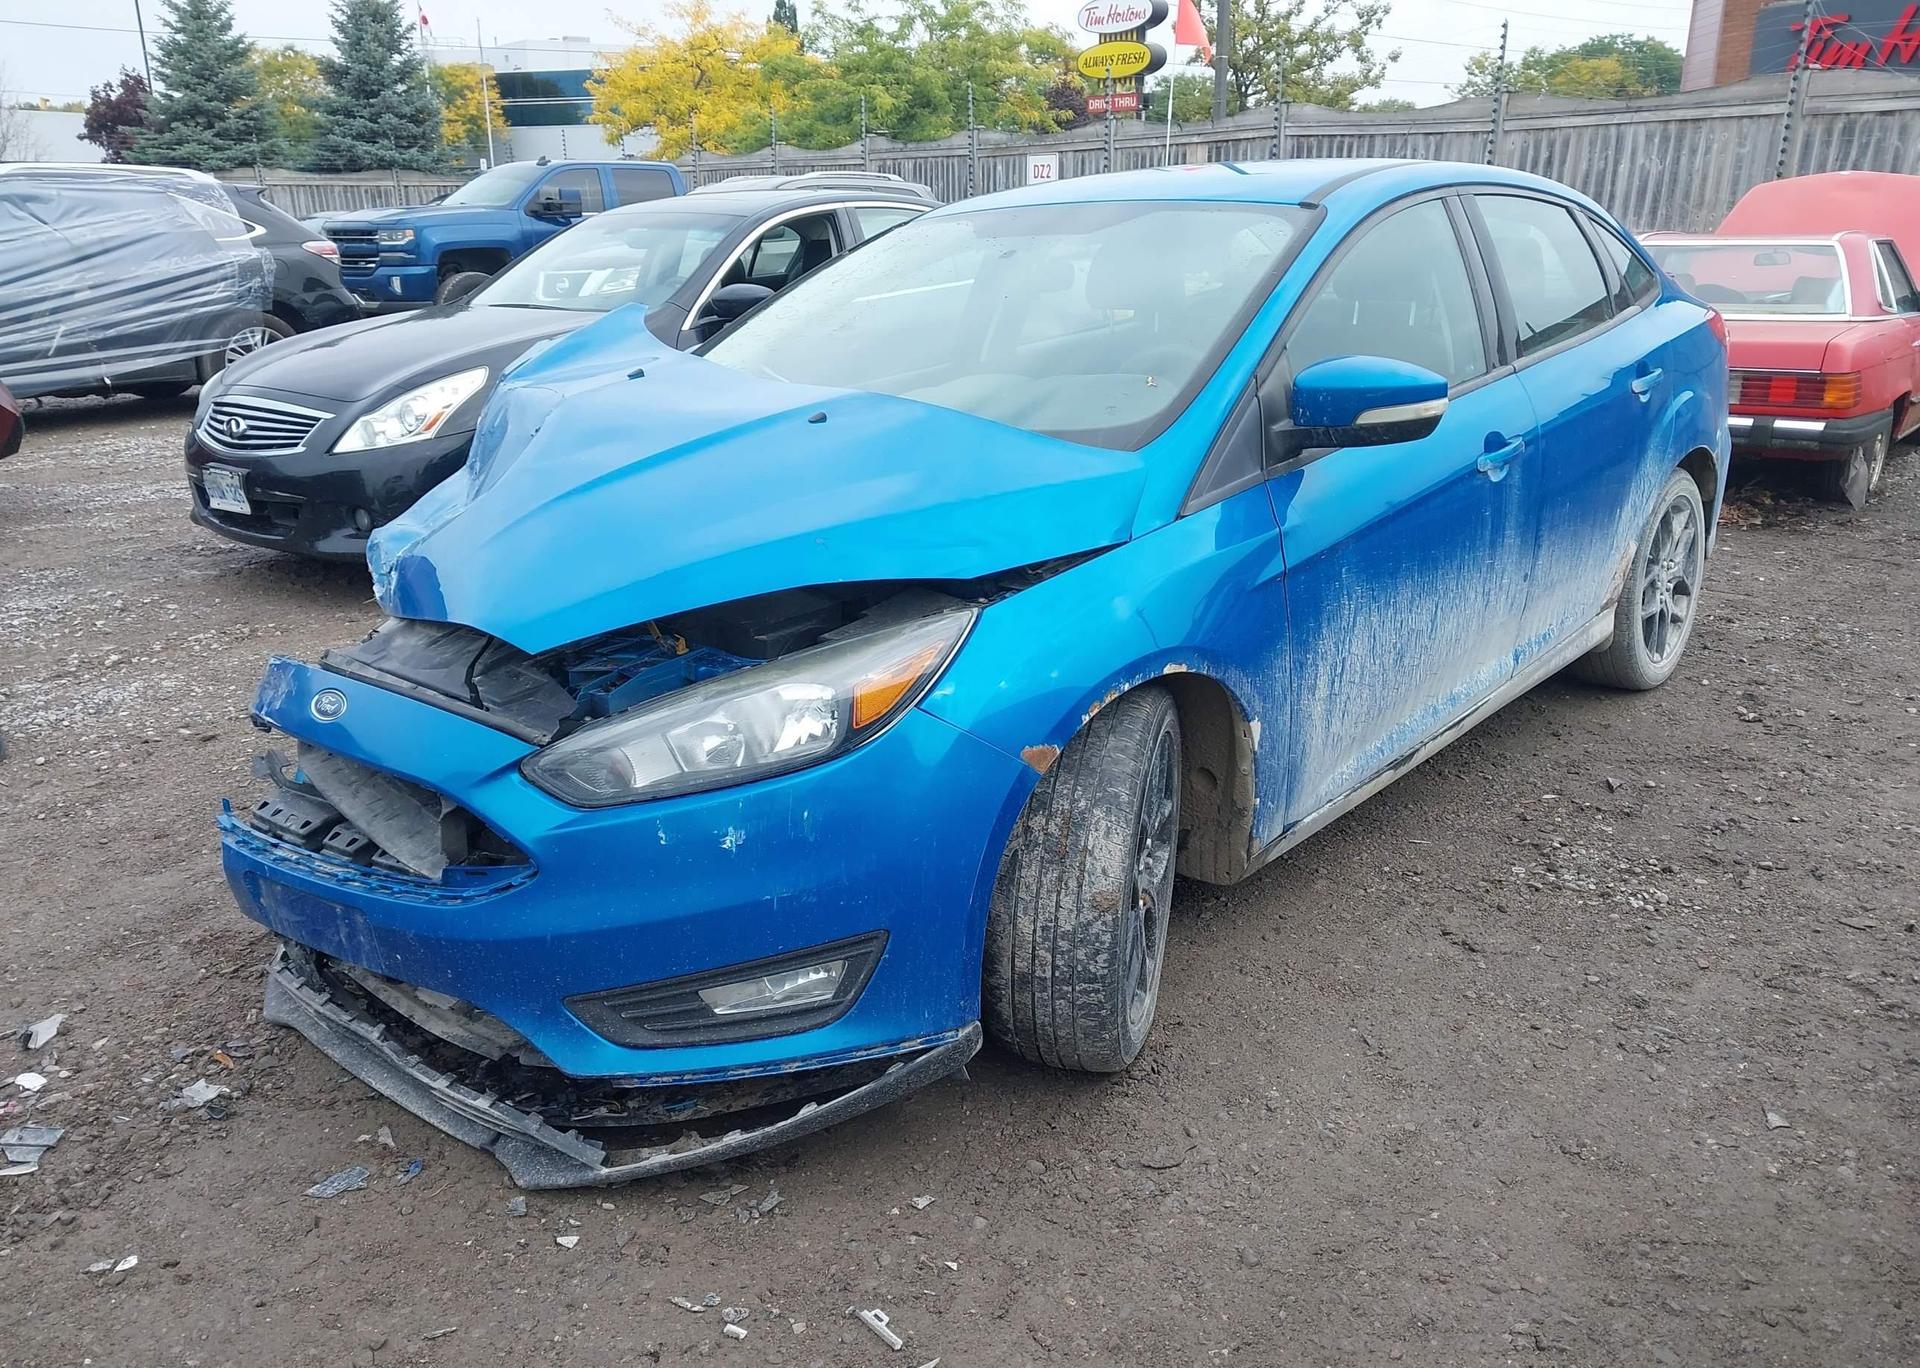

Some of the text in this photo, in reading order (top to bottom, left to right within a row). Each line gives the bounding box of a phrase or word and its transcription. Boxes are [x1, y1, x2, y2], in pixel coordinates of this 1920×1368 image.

[1085, 3, 1147, 27] Tim Hortons
[1787, 14, 1873, 71] Tim
[1082, 51, 1146, 68] ALWAYS FRESH
[1113, 96, 1137, 108] THRU
[1033, 163, 1052, 179] DZ2
[317, 695, 339, 714] Ford
